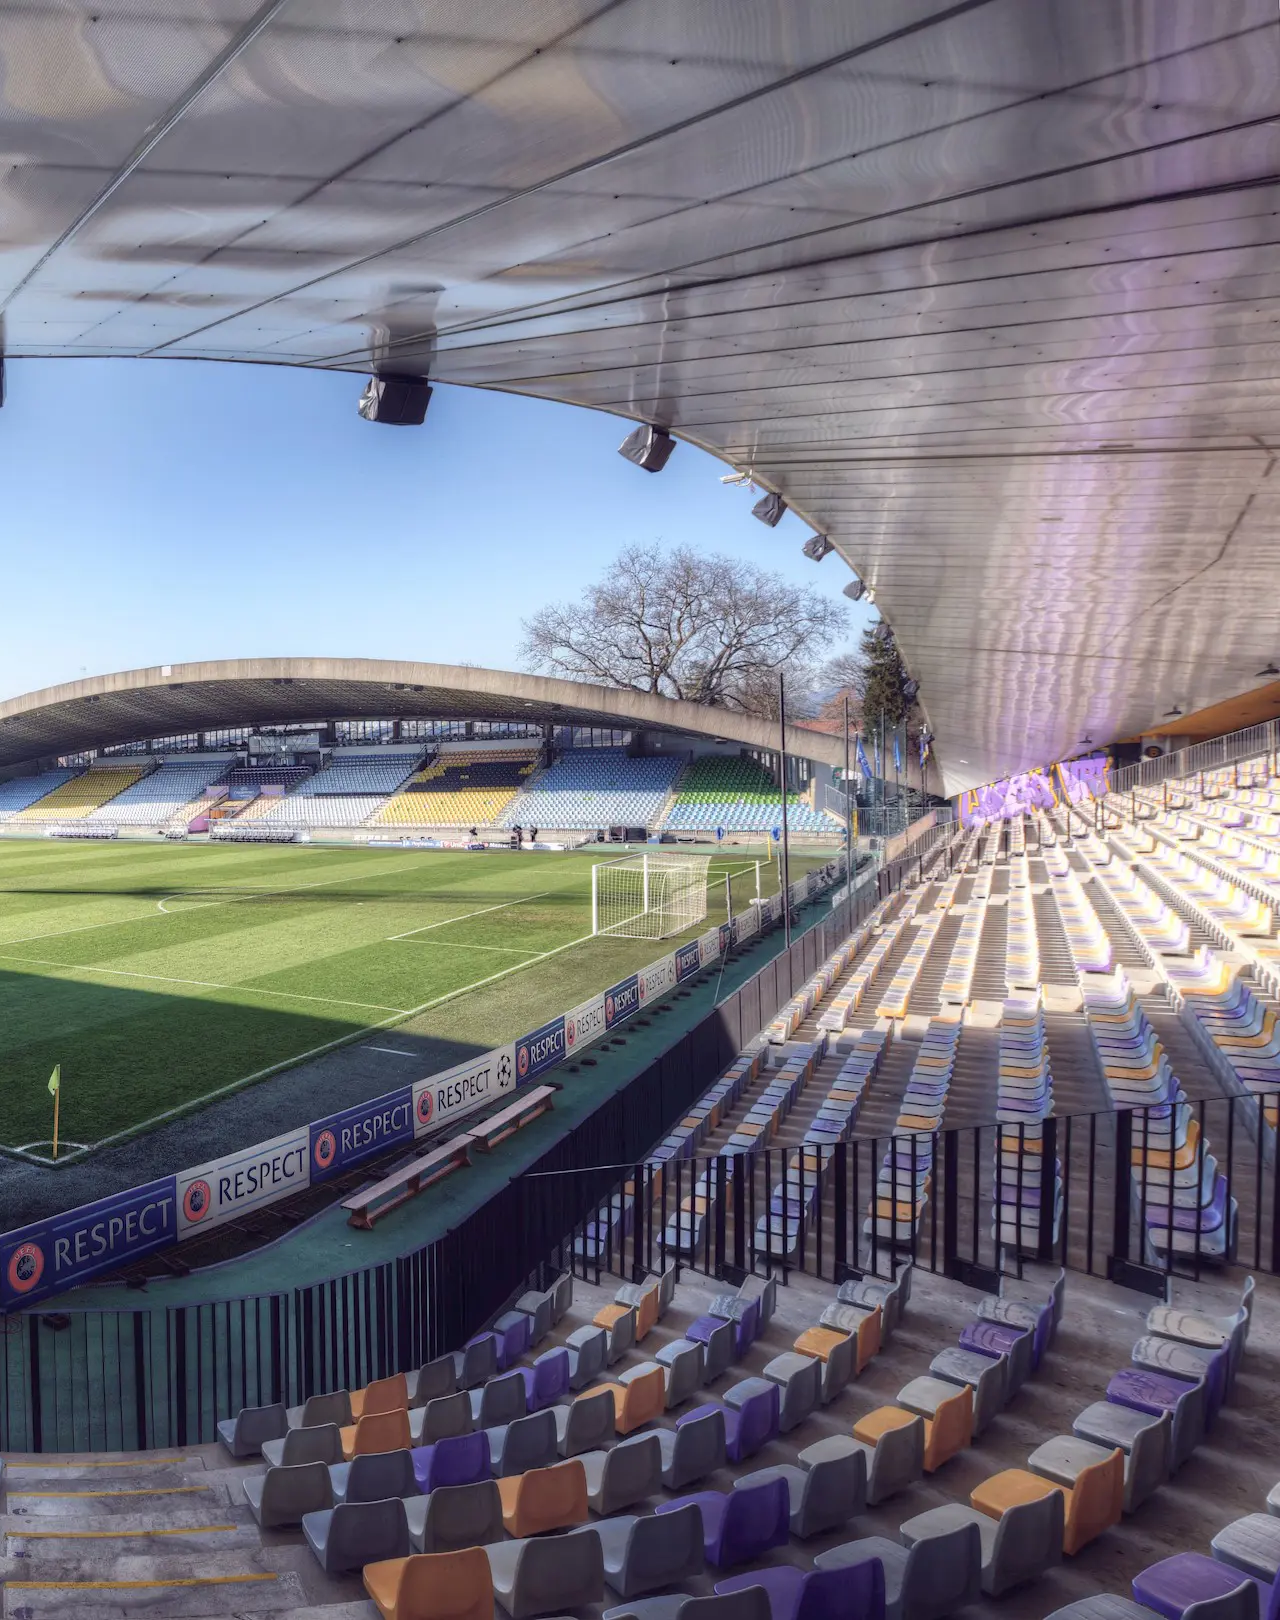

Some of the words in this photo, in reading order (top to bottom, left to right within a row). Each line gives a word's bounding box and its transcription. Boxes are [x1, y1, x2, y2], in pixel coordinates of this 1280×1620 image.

[681, 950, 699, 969] RESPECT
[645, 968, 666, 991] RESPECT
[614, 985, 638, 1012] RESPECT
[576, 1005, 604, 1036] RESPECT
[530, 1028, 565, 1066] RESPECT
[437, 1068, 491, 1112] RESPECT
[341, 1102, 411, 1153] RESPECT
[219, 1147, 307, 1205] RESPECT
[54, 1197, 173, 1271] RESPECT
[14, 1245, 36, 1260] UEFA
